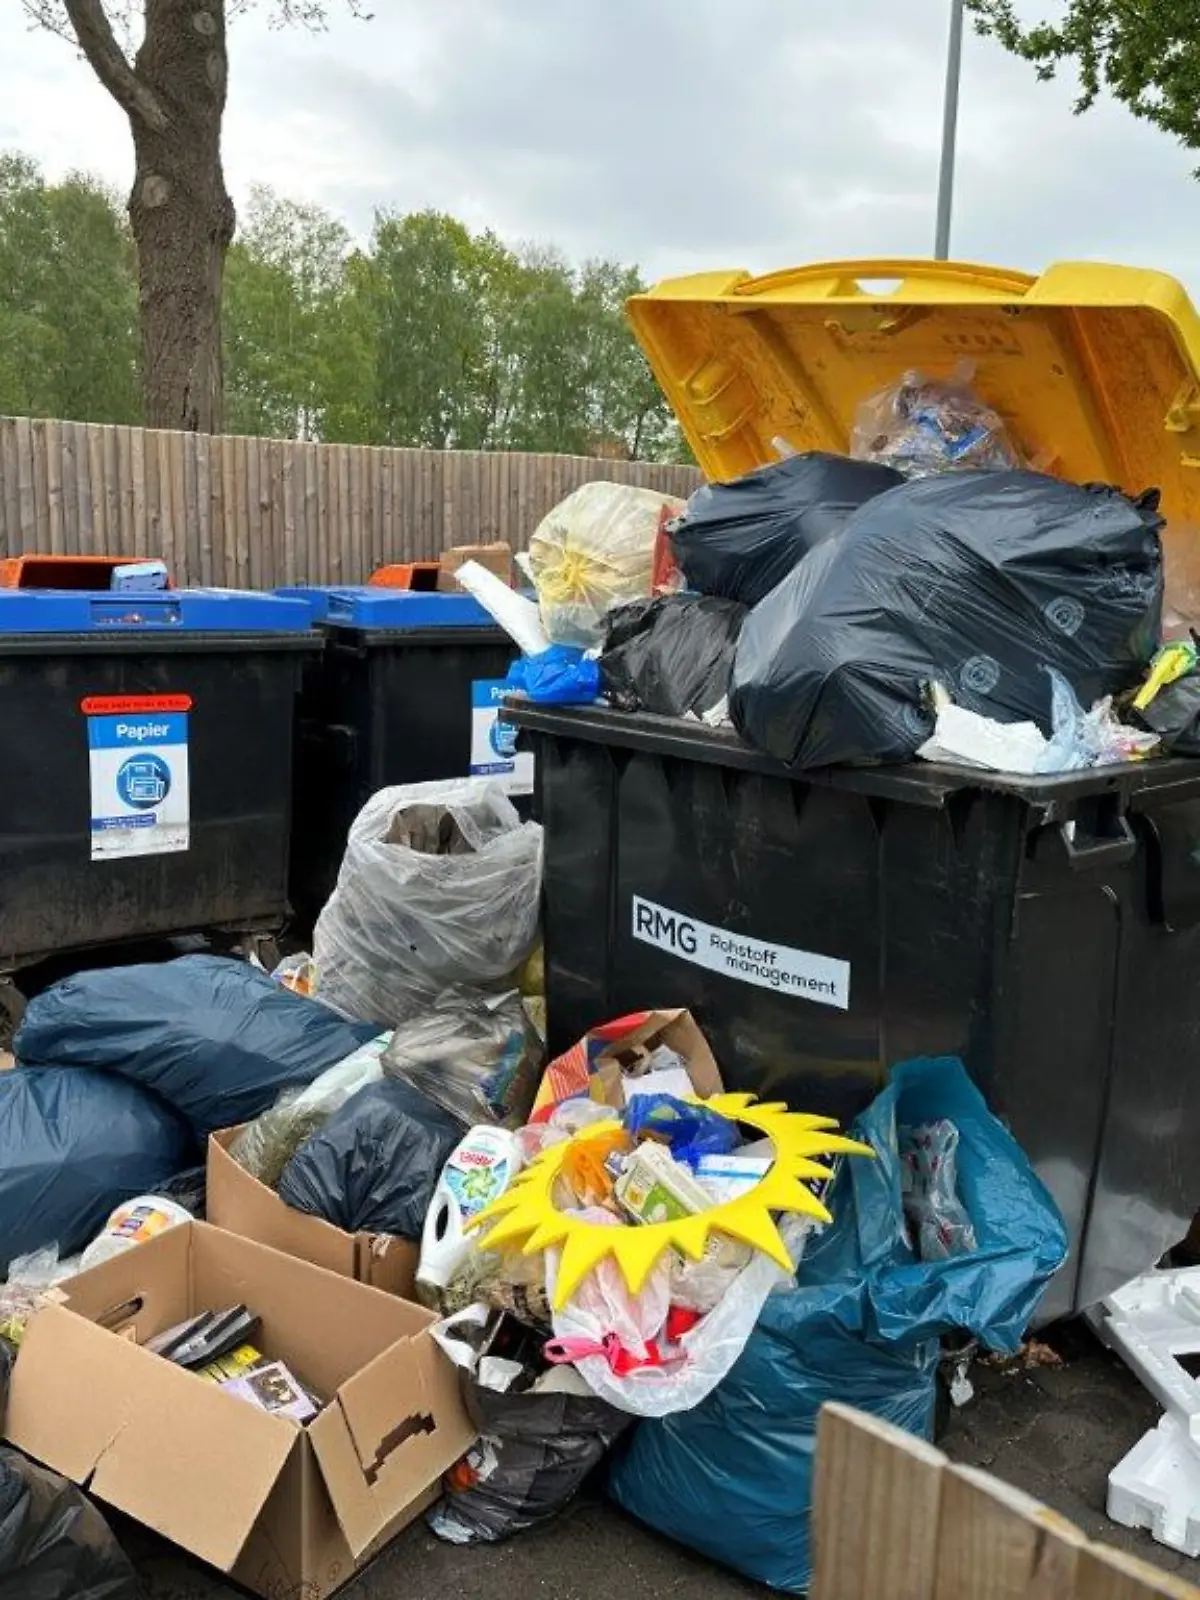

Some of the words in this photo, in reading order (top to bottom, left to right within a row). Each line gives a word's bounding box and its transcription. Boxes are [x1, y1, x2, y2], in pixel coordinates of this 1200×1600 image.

[116, 722, 170, 741] Papier
[636, 903, 698, 954] RMG
[709, 933, 777, 965] Rohstoff
[725, 955, 837, 996] management
